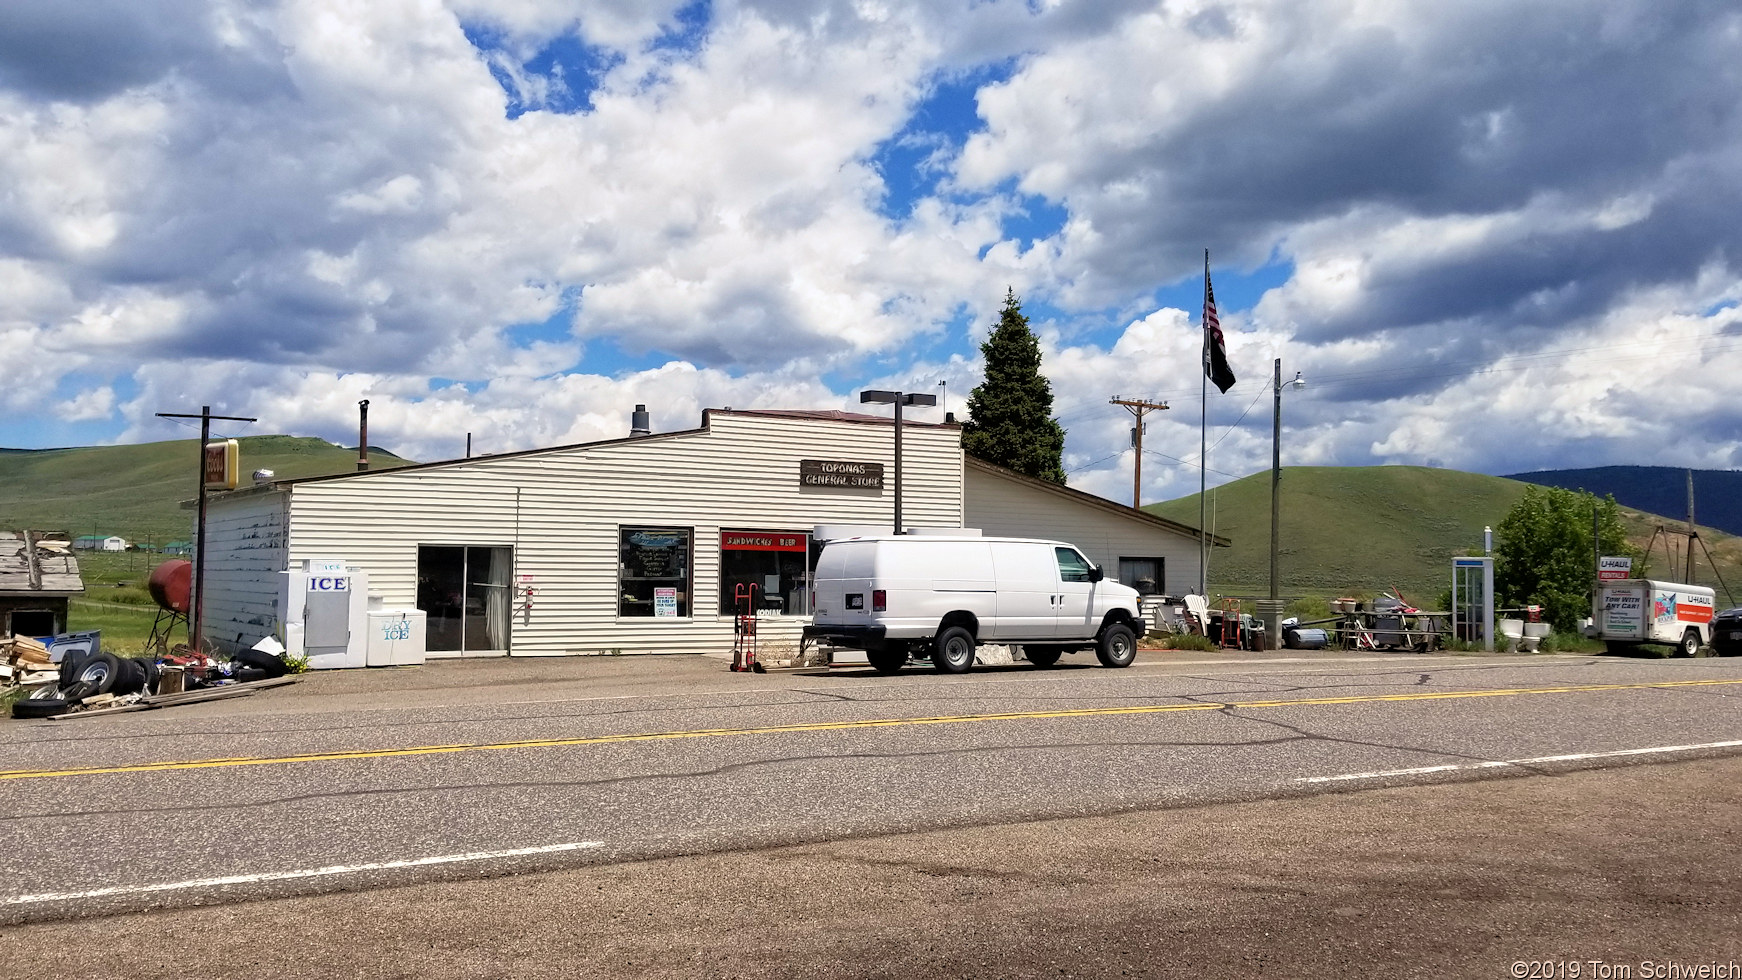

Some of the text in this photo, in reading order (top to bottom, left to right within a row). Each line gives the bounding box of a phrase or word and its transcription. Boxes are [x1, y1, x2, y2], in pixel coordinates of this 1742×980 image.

[820, 463, 866, 474] TOPONAS
[806, 474, 880, 487] GENERAL STORE
[727, 537, 796, 547] SANDWICHES BEER
[1601, 560, 1630, 568] U-HAUL
[310, 577, 346, 591] ICE
[1688, 596, 1711, 605] U-HAUL
[381, 620, 412, 631] DRY
[383, 630, 409, 640] ICE
